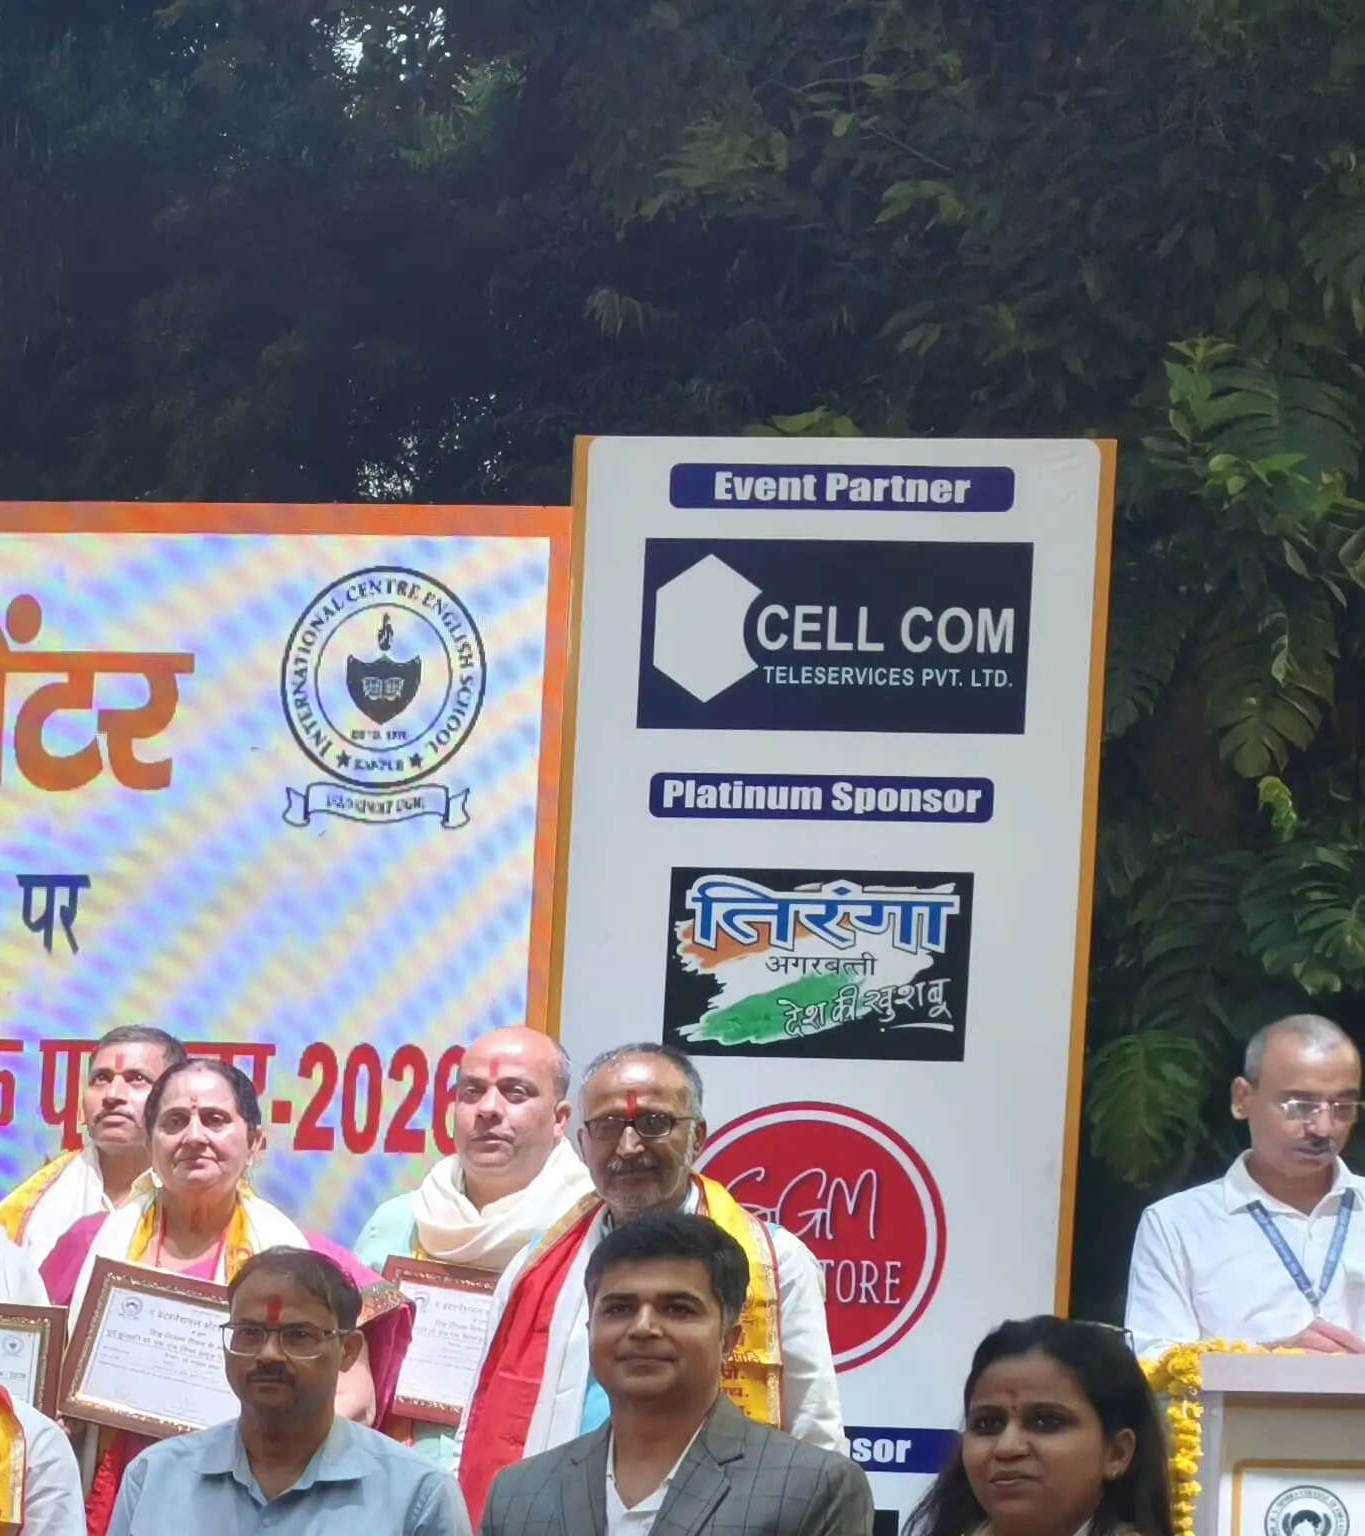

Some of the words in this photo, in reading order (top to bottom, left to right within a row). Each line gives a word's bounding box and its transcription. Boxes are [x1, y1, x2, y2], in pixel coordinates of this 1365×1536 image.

[714, 472, 817, 500] Event
[825, 474, 971, 503] Partner
[346, 578, 421, 601] CENTRE
[423, 591, 474, 668] ENGLISH
[756, 605, 884, 651] CELL
[901, 608, 1014, 653] COM
[293, 596, 345, 758] INTERNATIONAL
[763, 666, 913, 686] TELESERVICES
[922, 668, 962, 687] PVT.
[972, 669, 1012, 688] LTD.
[426, 675, 472, 752] SCHOOL
[663, 780, 822, 810] Platinum
[831, 782, 981, 813] Sponsor
[17, 874, 90, 954] पर
[686, 876, 960, 953] तिरंगा
[765, 956, 877, 976] अगरबत्ती
[819, 1259, 902, 1304] TORE
